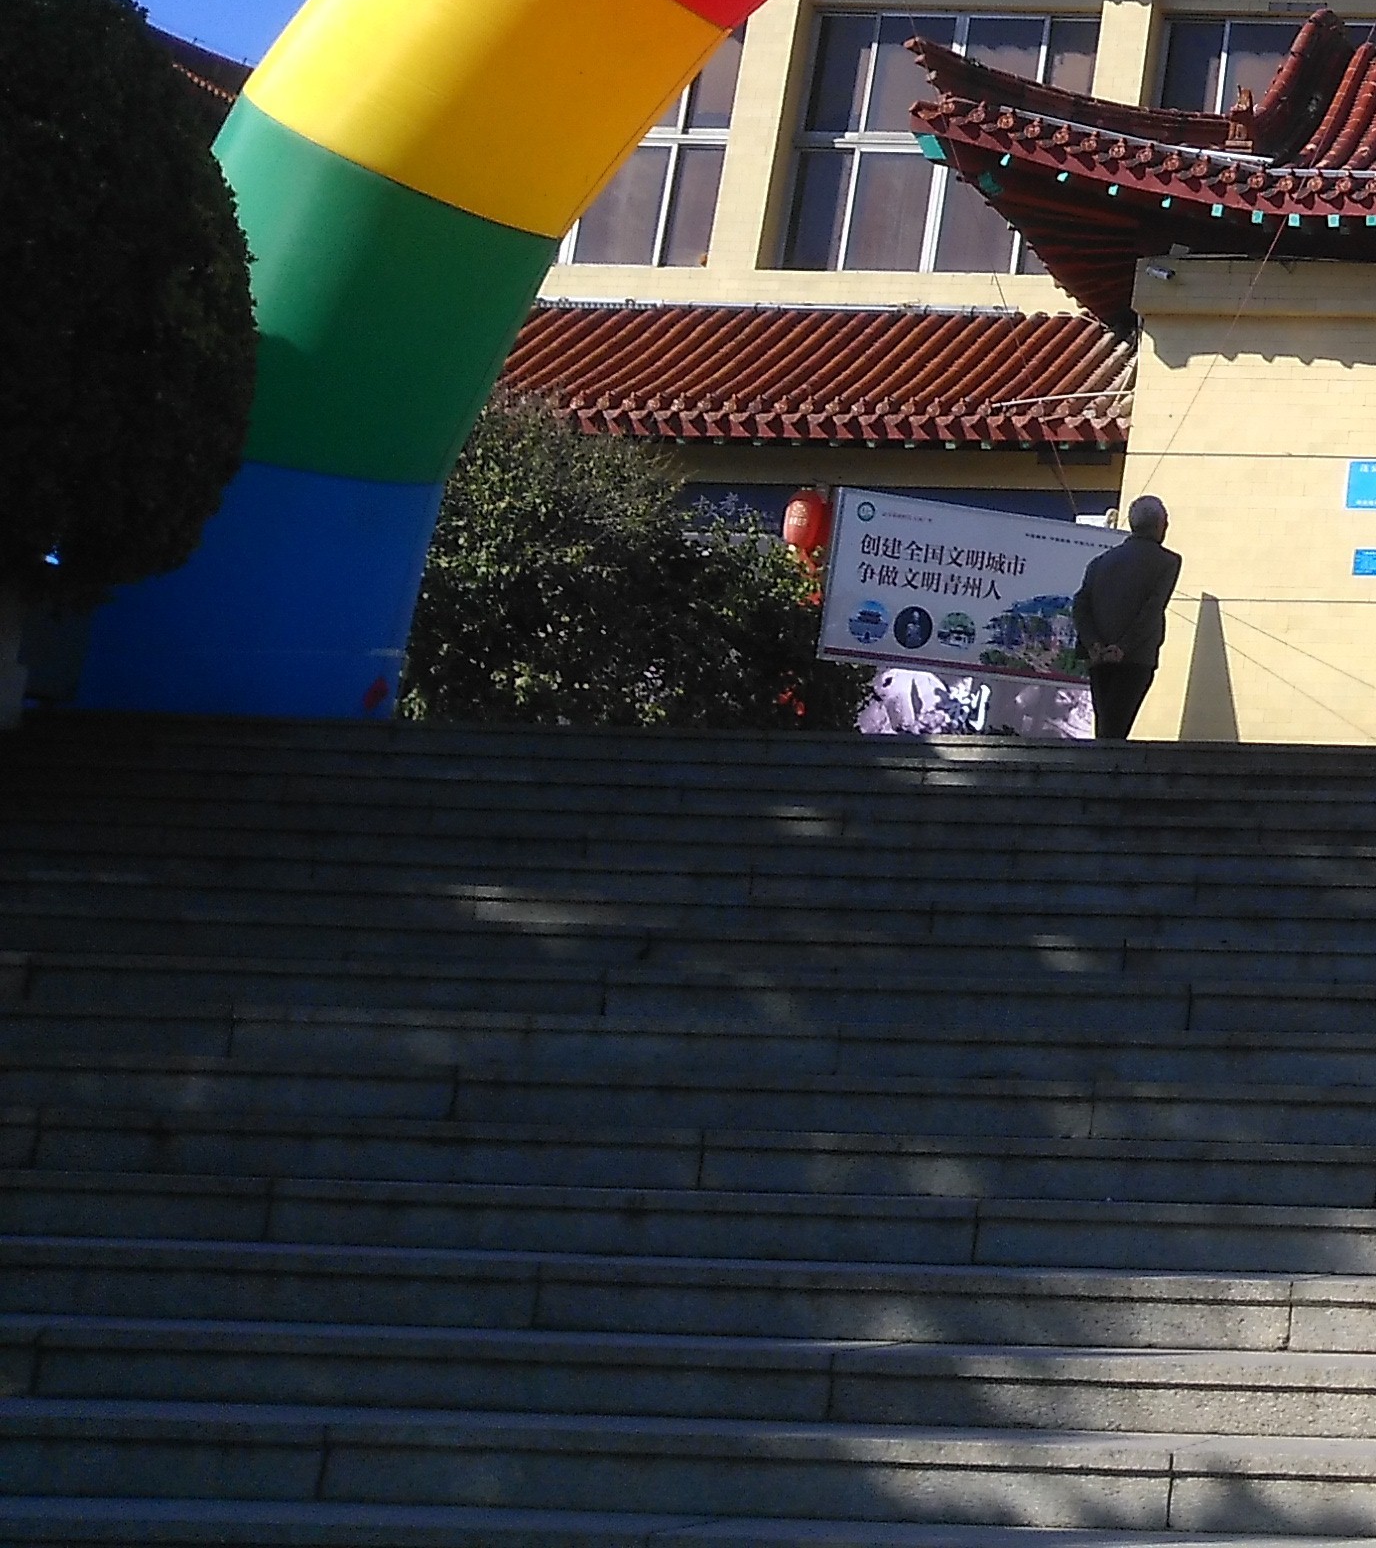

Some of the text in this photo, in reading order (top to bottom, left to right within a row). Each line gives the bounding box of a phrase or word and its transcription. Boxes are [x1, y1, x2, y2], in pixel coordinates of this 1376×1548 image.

[861, 533, 1027, 577] 创建全国文明城市
[857, 561, 1002, 601] 争做文明青州人
